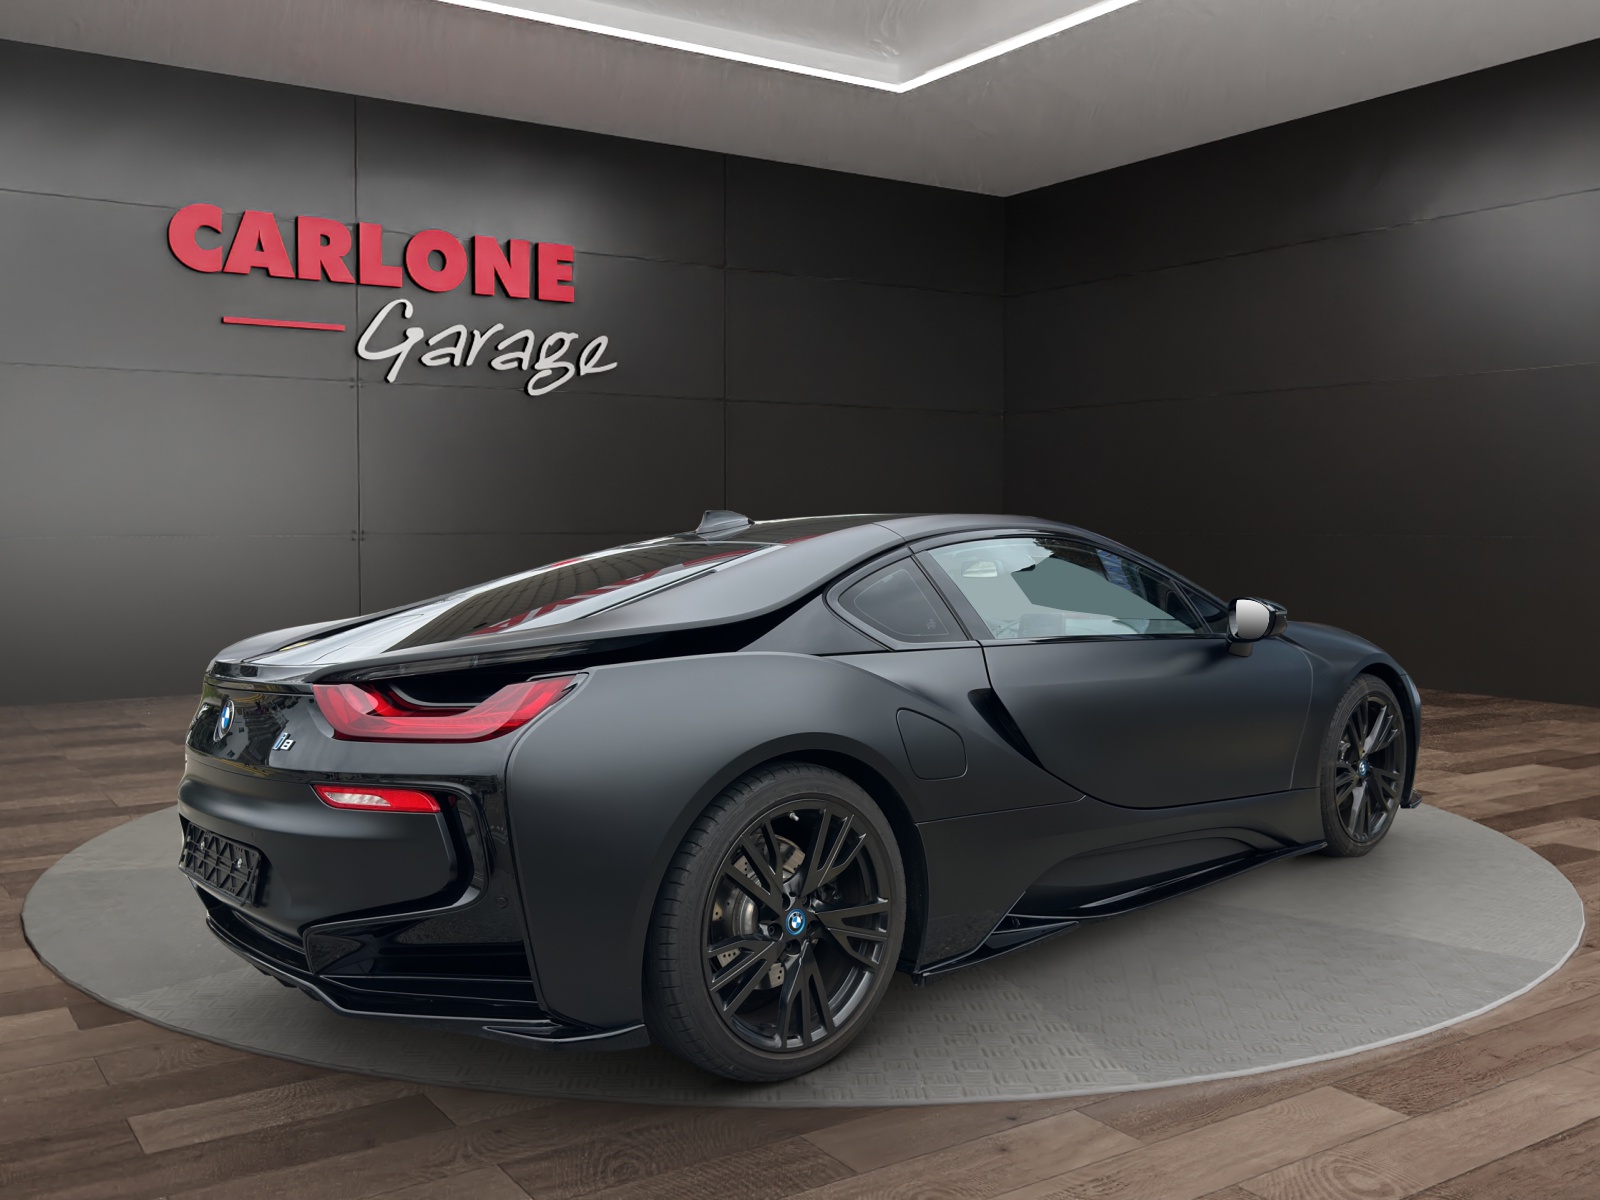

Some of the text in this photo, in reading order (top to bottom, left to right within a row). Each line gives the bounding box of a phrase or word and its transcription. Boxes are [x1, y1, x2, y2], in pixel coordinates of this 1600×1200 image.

[167, 203, 576, 303] CARLONE
[356, 298, 618, 396] Garage
[272, 732, 295, 751] i8
